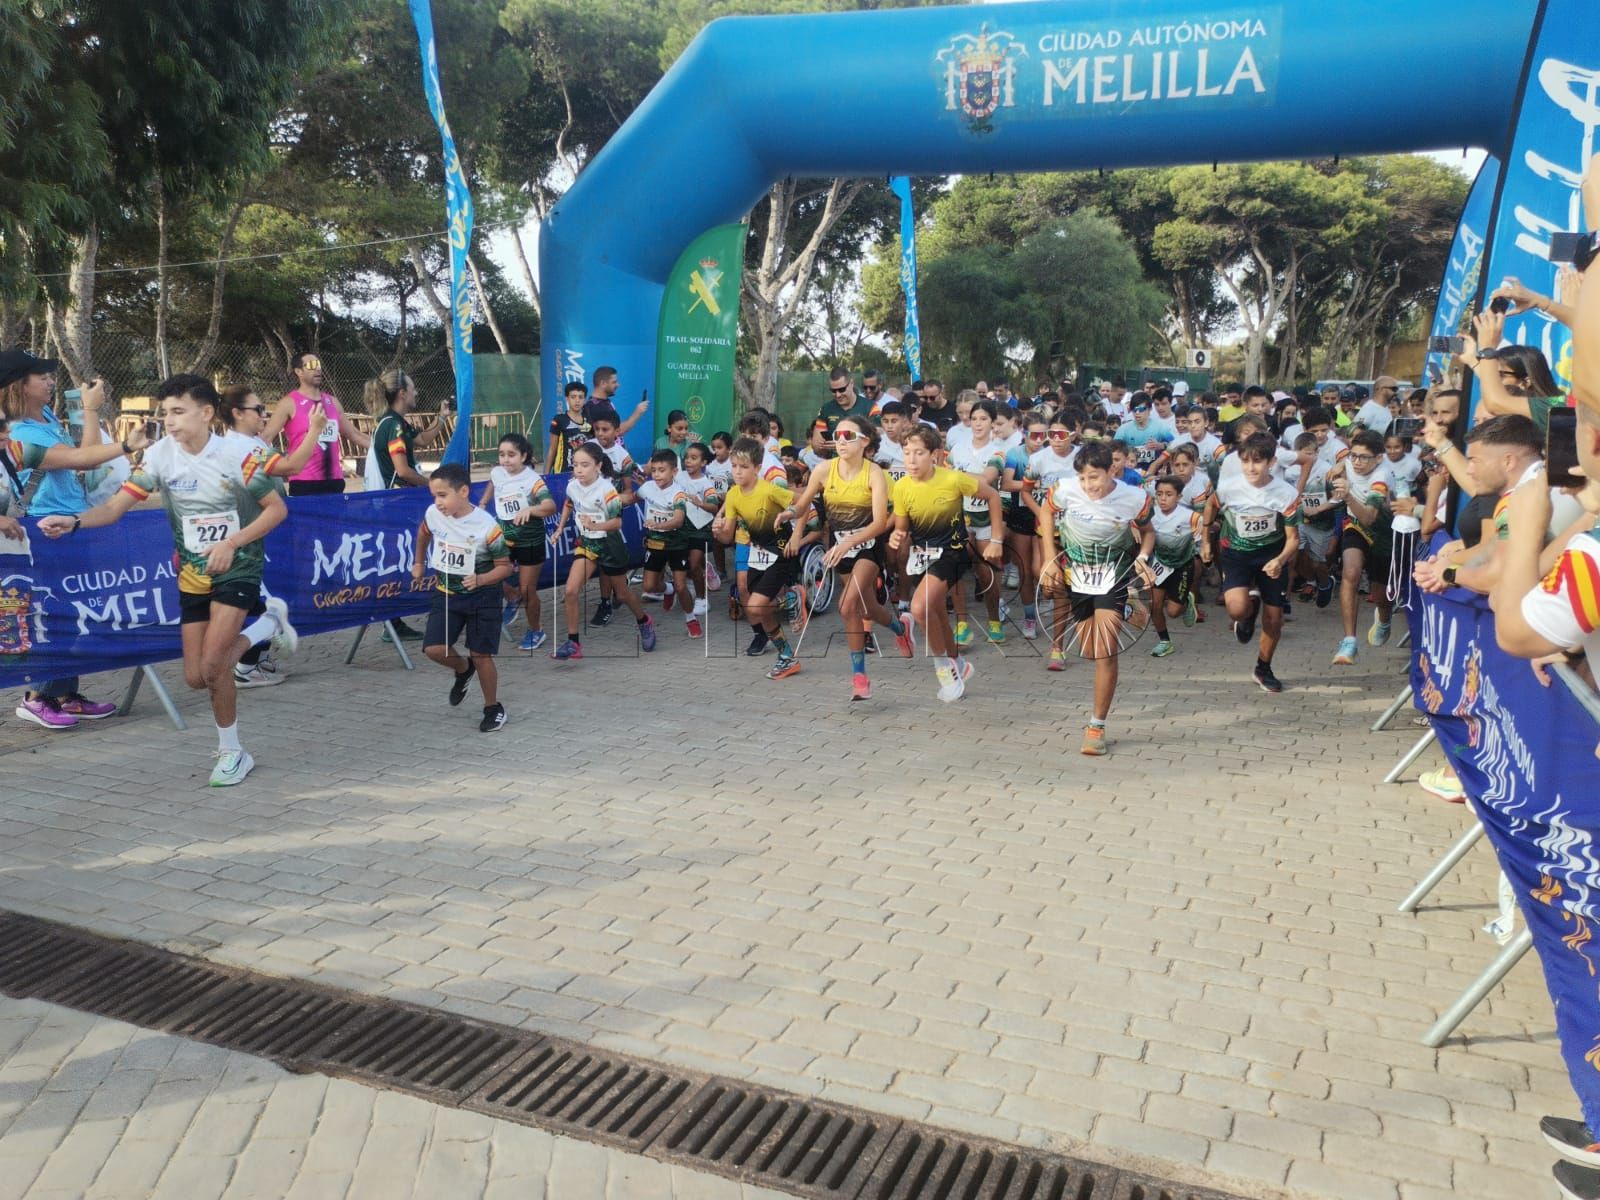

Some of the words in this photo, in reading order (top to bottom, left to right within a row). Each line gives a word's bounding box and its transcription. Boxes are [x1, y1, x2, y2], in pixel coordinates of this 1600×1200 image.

[1038, 29, 1122, 54] CIUDAD
[1127, 18, 1268, 48] AUTÓNOMA
[1057, 57, 1073, 70] DE
[1041, 45, 1268, 107] MELILLA
[664, 335, 688, 344] TRAIL
[689, 336, 732, 347] SOLIDARIA
[667, 362, 701, 371] GUARDIA
[701, 363, 721, 372] CIVIL
[677, 371, 709, 380] MELILLA
[503, 499, 521, 514] 160
[1243, 519, 1269, 532] 235
[196, 524, 229, 543] 222
[440, 549, 465, 568] 204
[61, 565, 147, 594] CIUDAD
[313, 584, 372, 609] CIUDAD
[376, 579, 402, 600] DEL
[88, 597, 104, 609] DE
